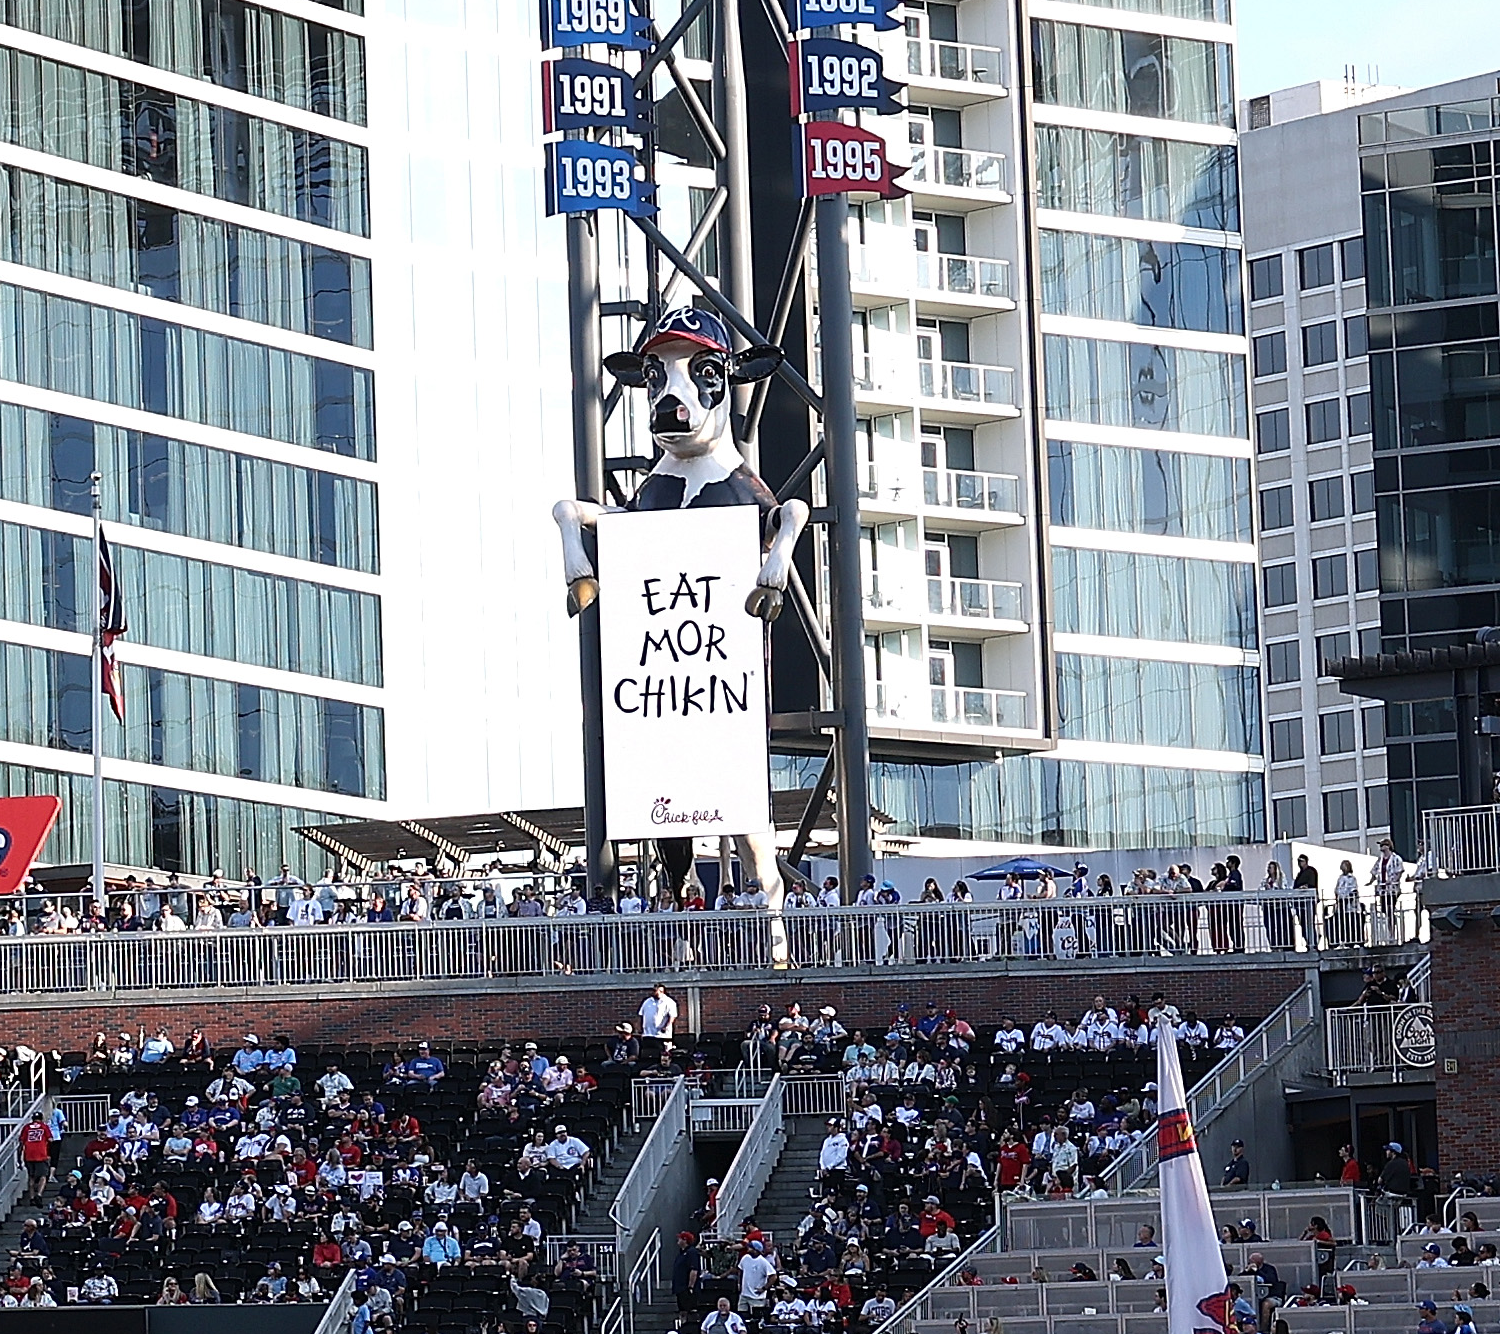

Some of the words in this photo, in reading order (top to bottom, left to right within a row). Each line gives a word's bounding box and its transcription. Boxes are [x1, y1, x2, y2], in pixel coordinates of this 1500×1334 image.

[558, 74, 627, 116] 1991
[807, 55, 879, 97] 1992
[560, 156, 632, 199] 1993
[810, 138, 882, 181] 1995
[642, 572, 721, 615] EAT
[639, 620, 728, 665] MOR
[613, 671, 750, 717] CHIKIN
[650, 797, 725, 825] Chick-fil-A
